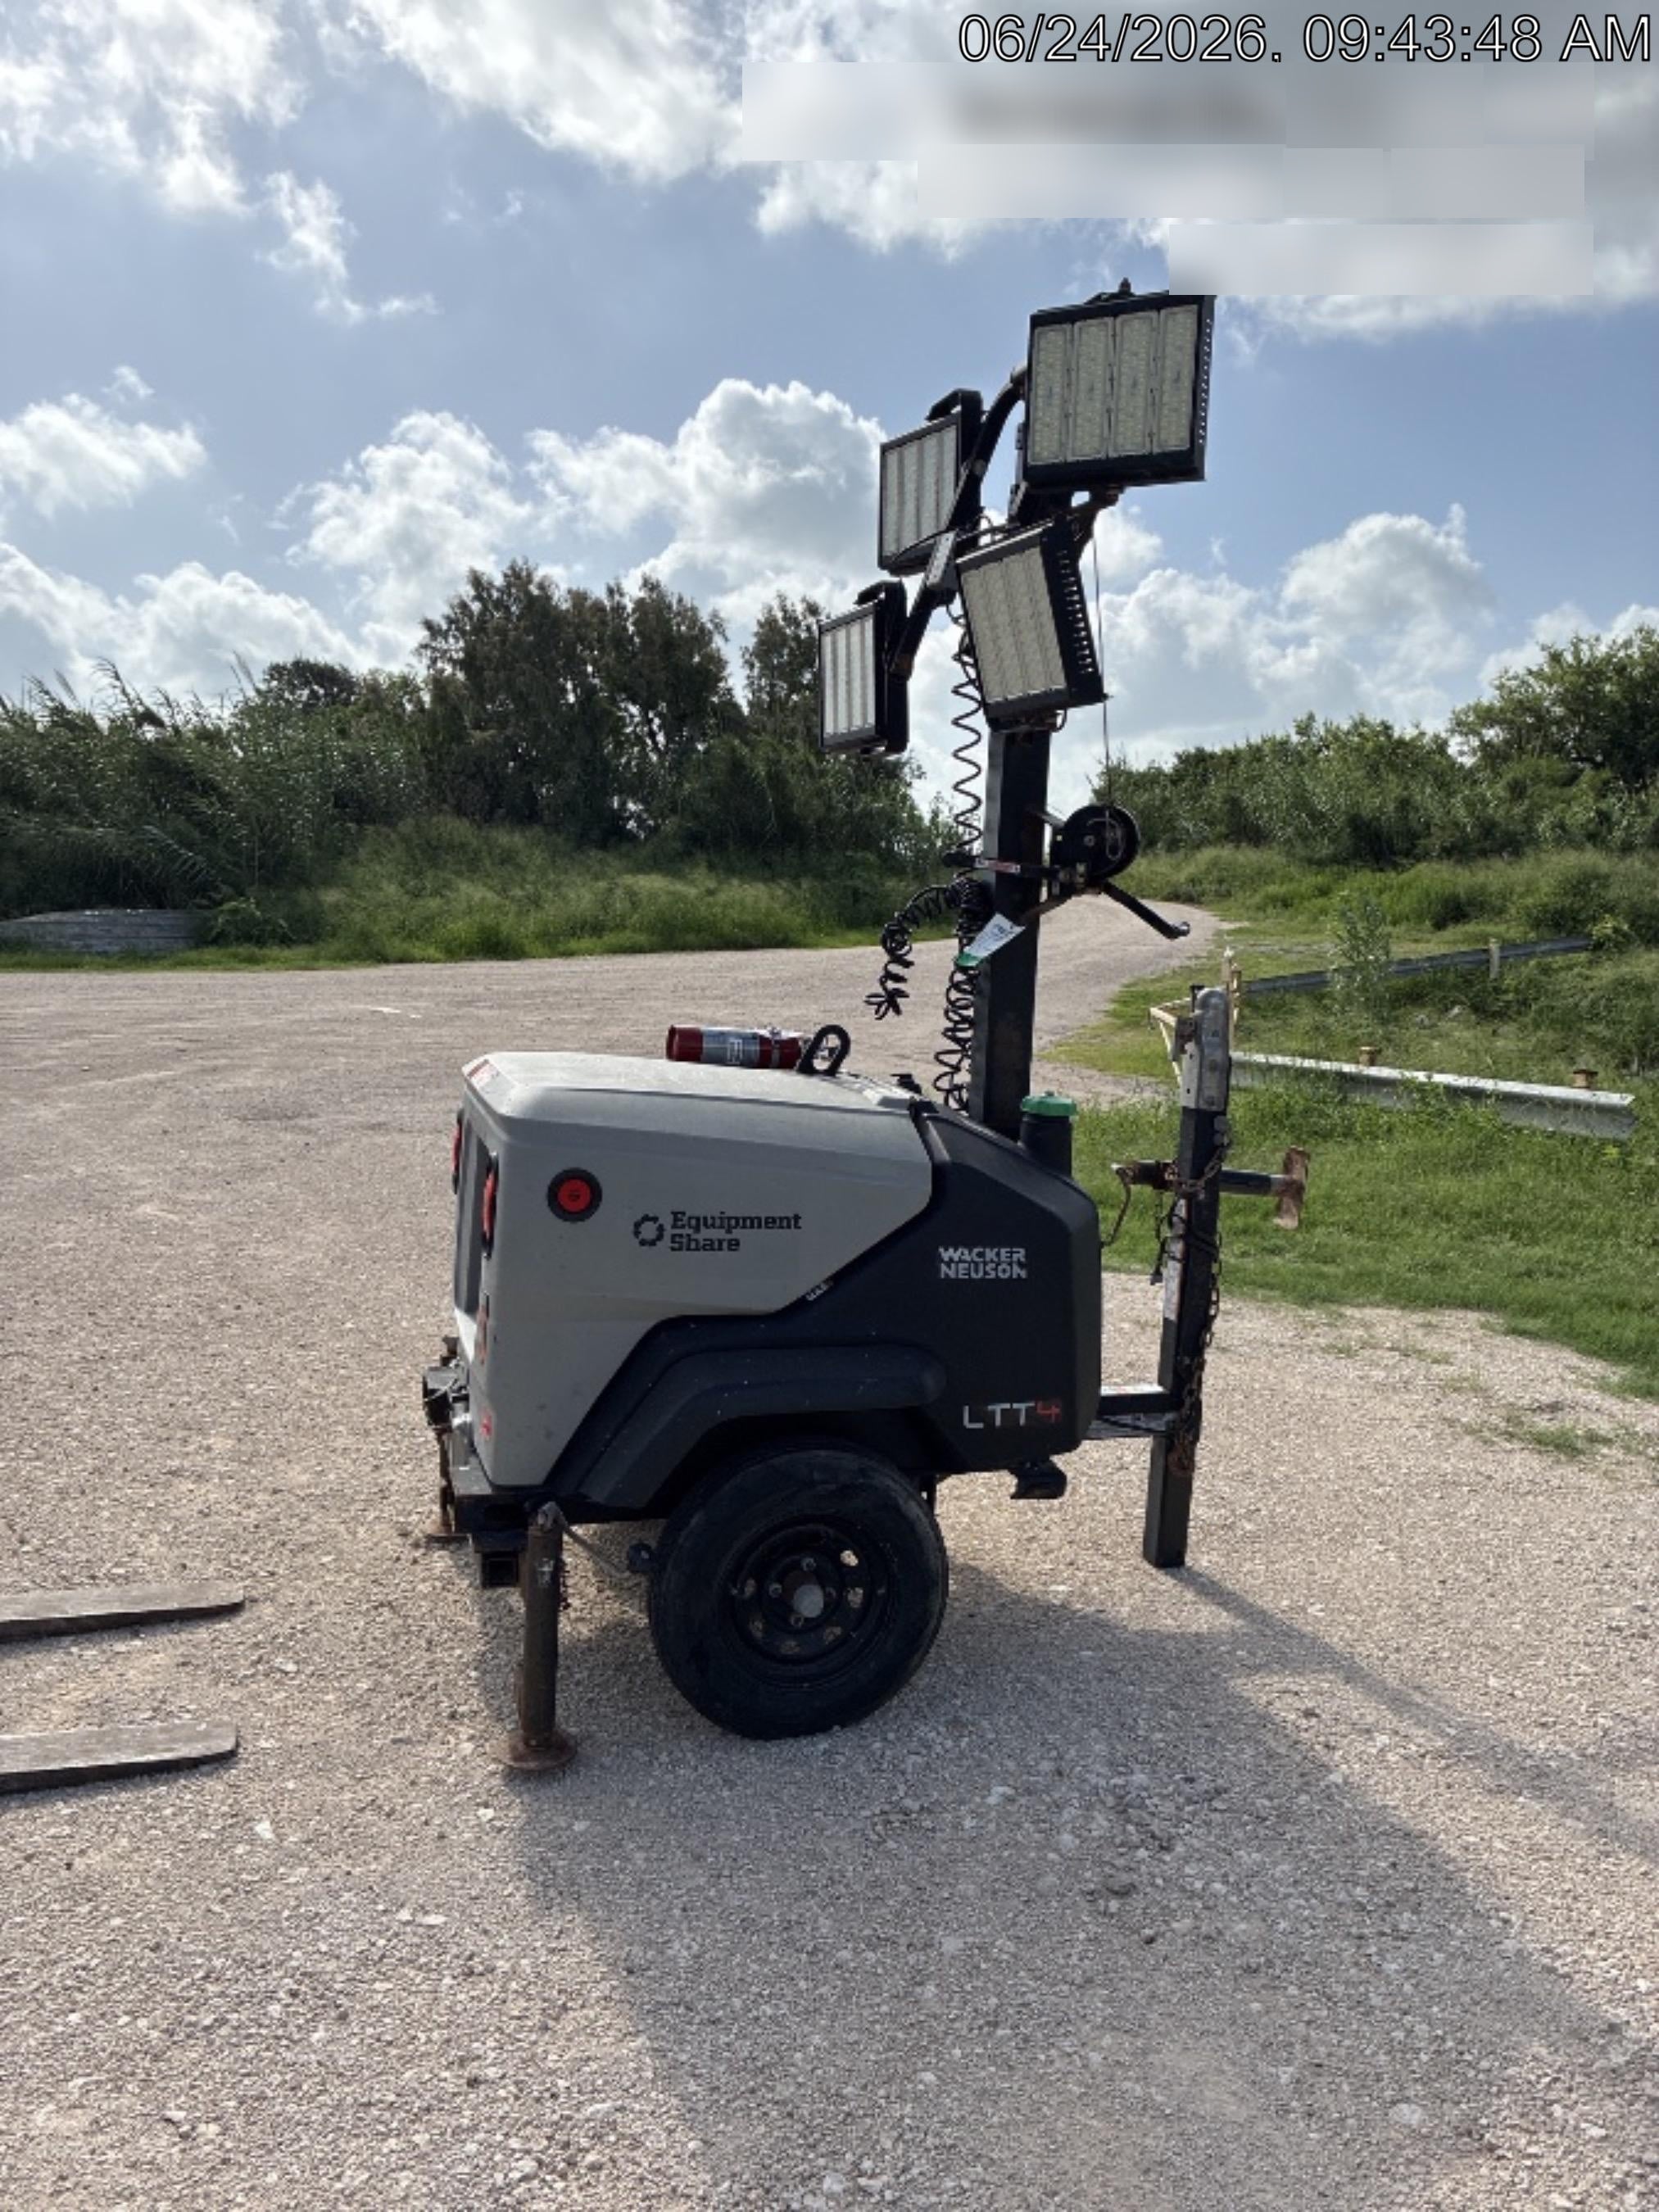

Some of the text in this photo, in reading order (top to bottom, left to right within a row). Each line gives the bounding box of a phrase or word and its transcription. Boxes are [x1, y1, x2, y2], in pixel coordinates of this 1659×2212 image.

[670, 1211, 802, 1234] Equipment
[670, 1233, 741, 1252] Share
[938, 1247, 1026, 1262] WACKER
[940, 1262, 1027, 1279] NEUSON
[963, 1401, 1060, 1429] LTT4
